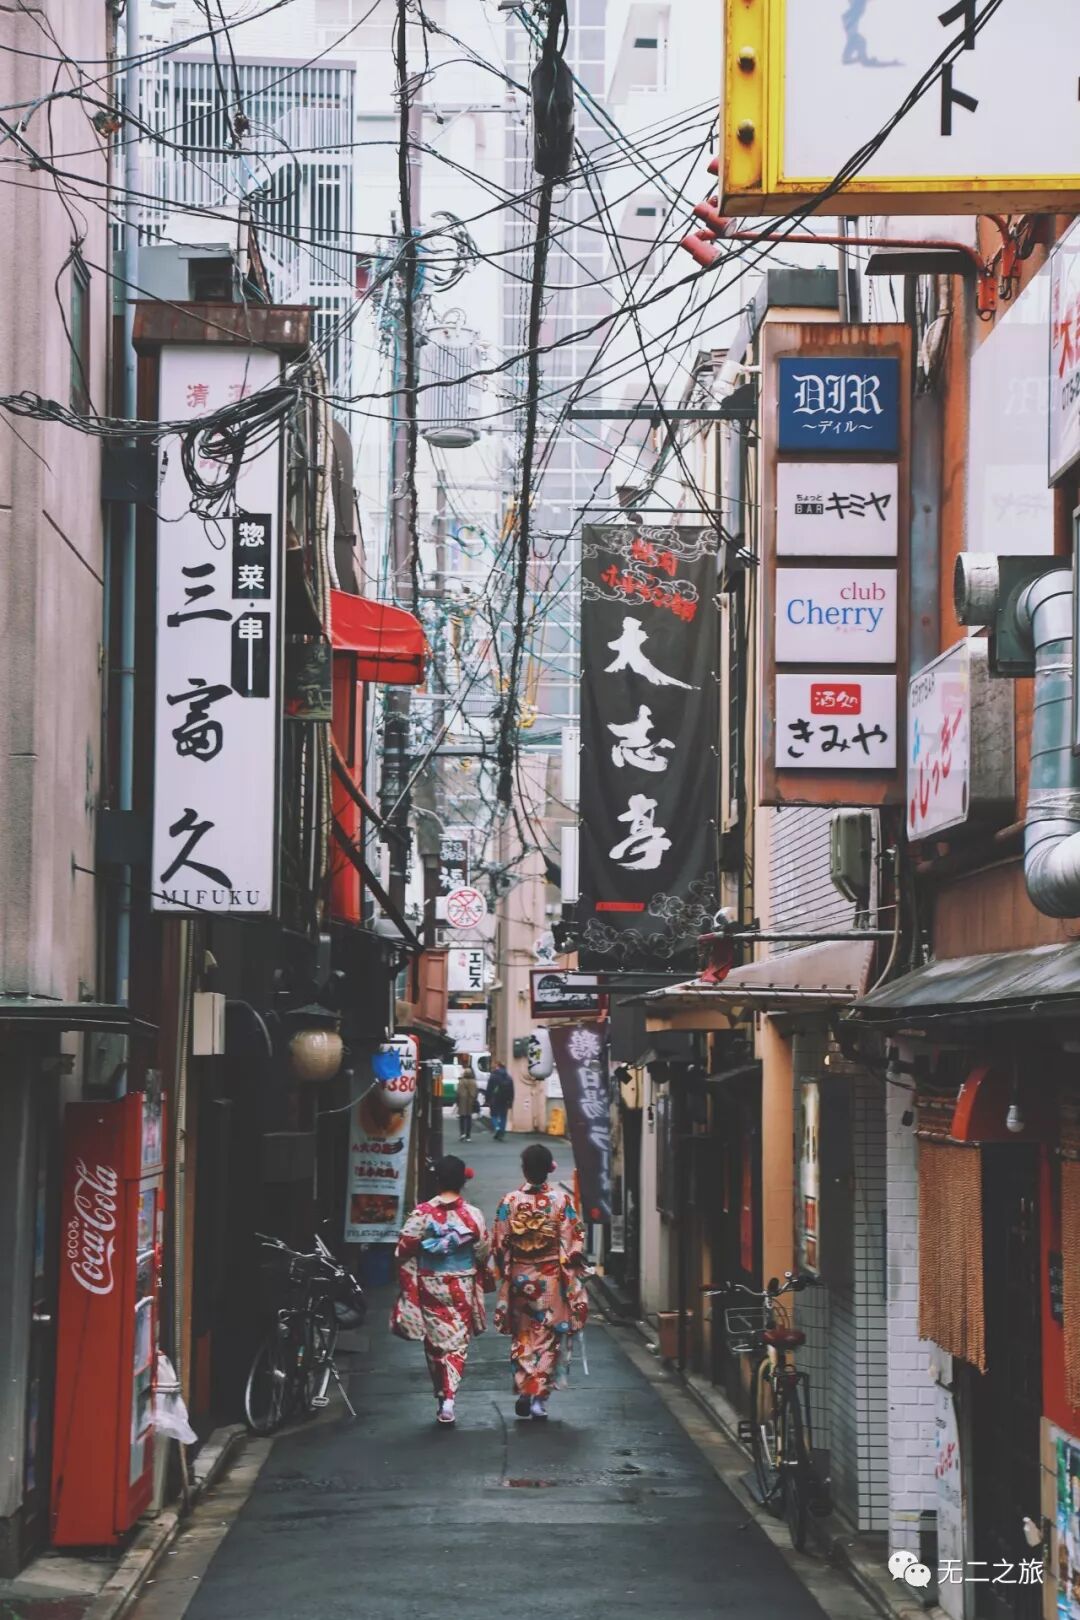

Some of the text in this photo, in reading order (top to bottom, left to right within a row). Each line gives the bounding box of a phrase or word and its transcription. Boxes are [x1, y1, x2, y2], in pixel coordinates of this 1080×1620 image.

[791, 373, 884, 415] DIR
[796, 493, 823, 502] ちょっと
[796, 503, 823, 514] BAR
[825, 491, 892, 521] キミヤ
[840, 582, 886, 601] club
[787, 598, 884, 633] Cherry
[787, 717, 889, 759] きみや
[160, 889, 261, 906] MIFUKU
[70, 1157, 119, 1296] Coca-Cola
